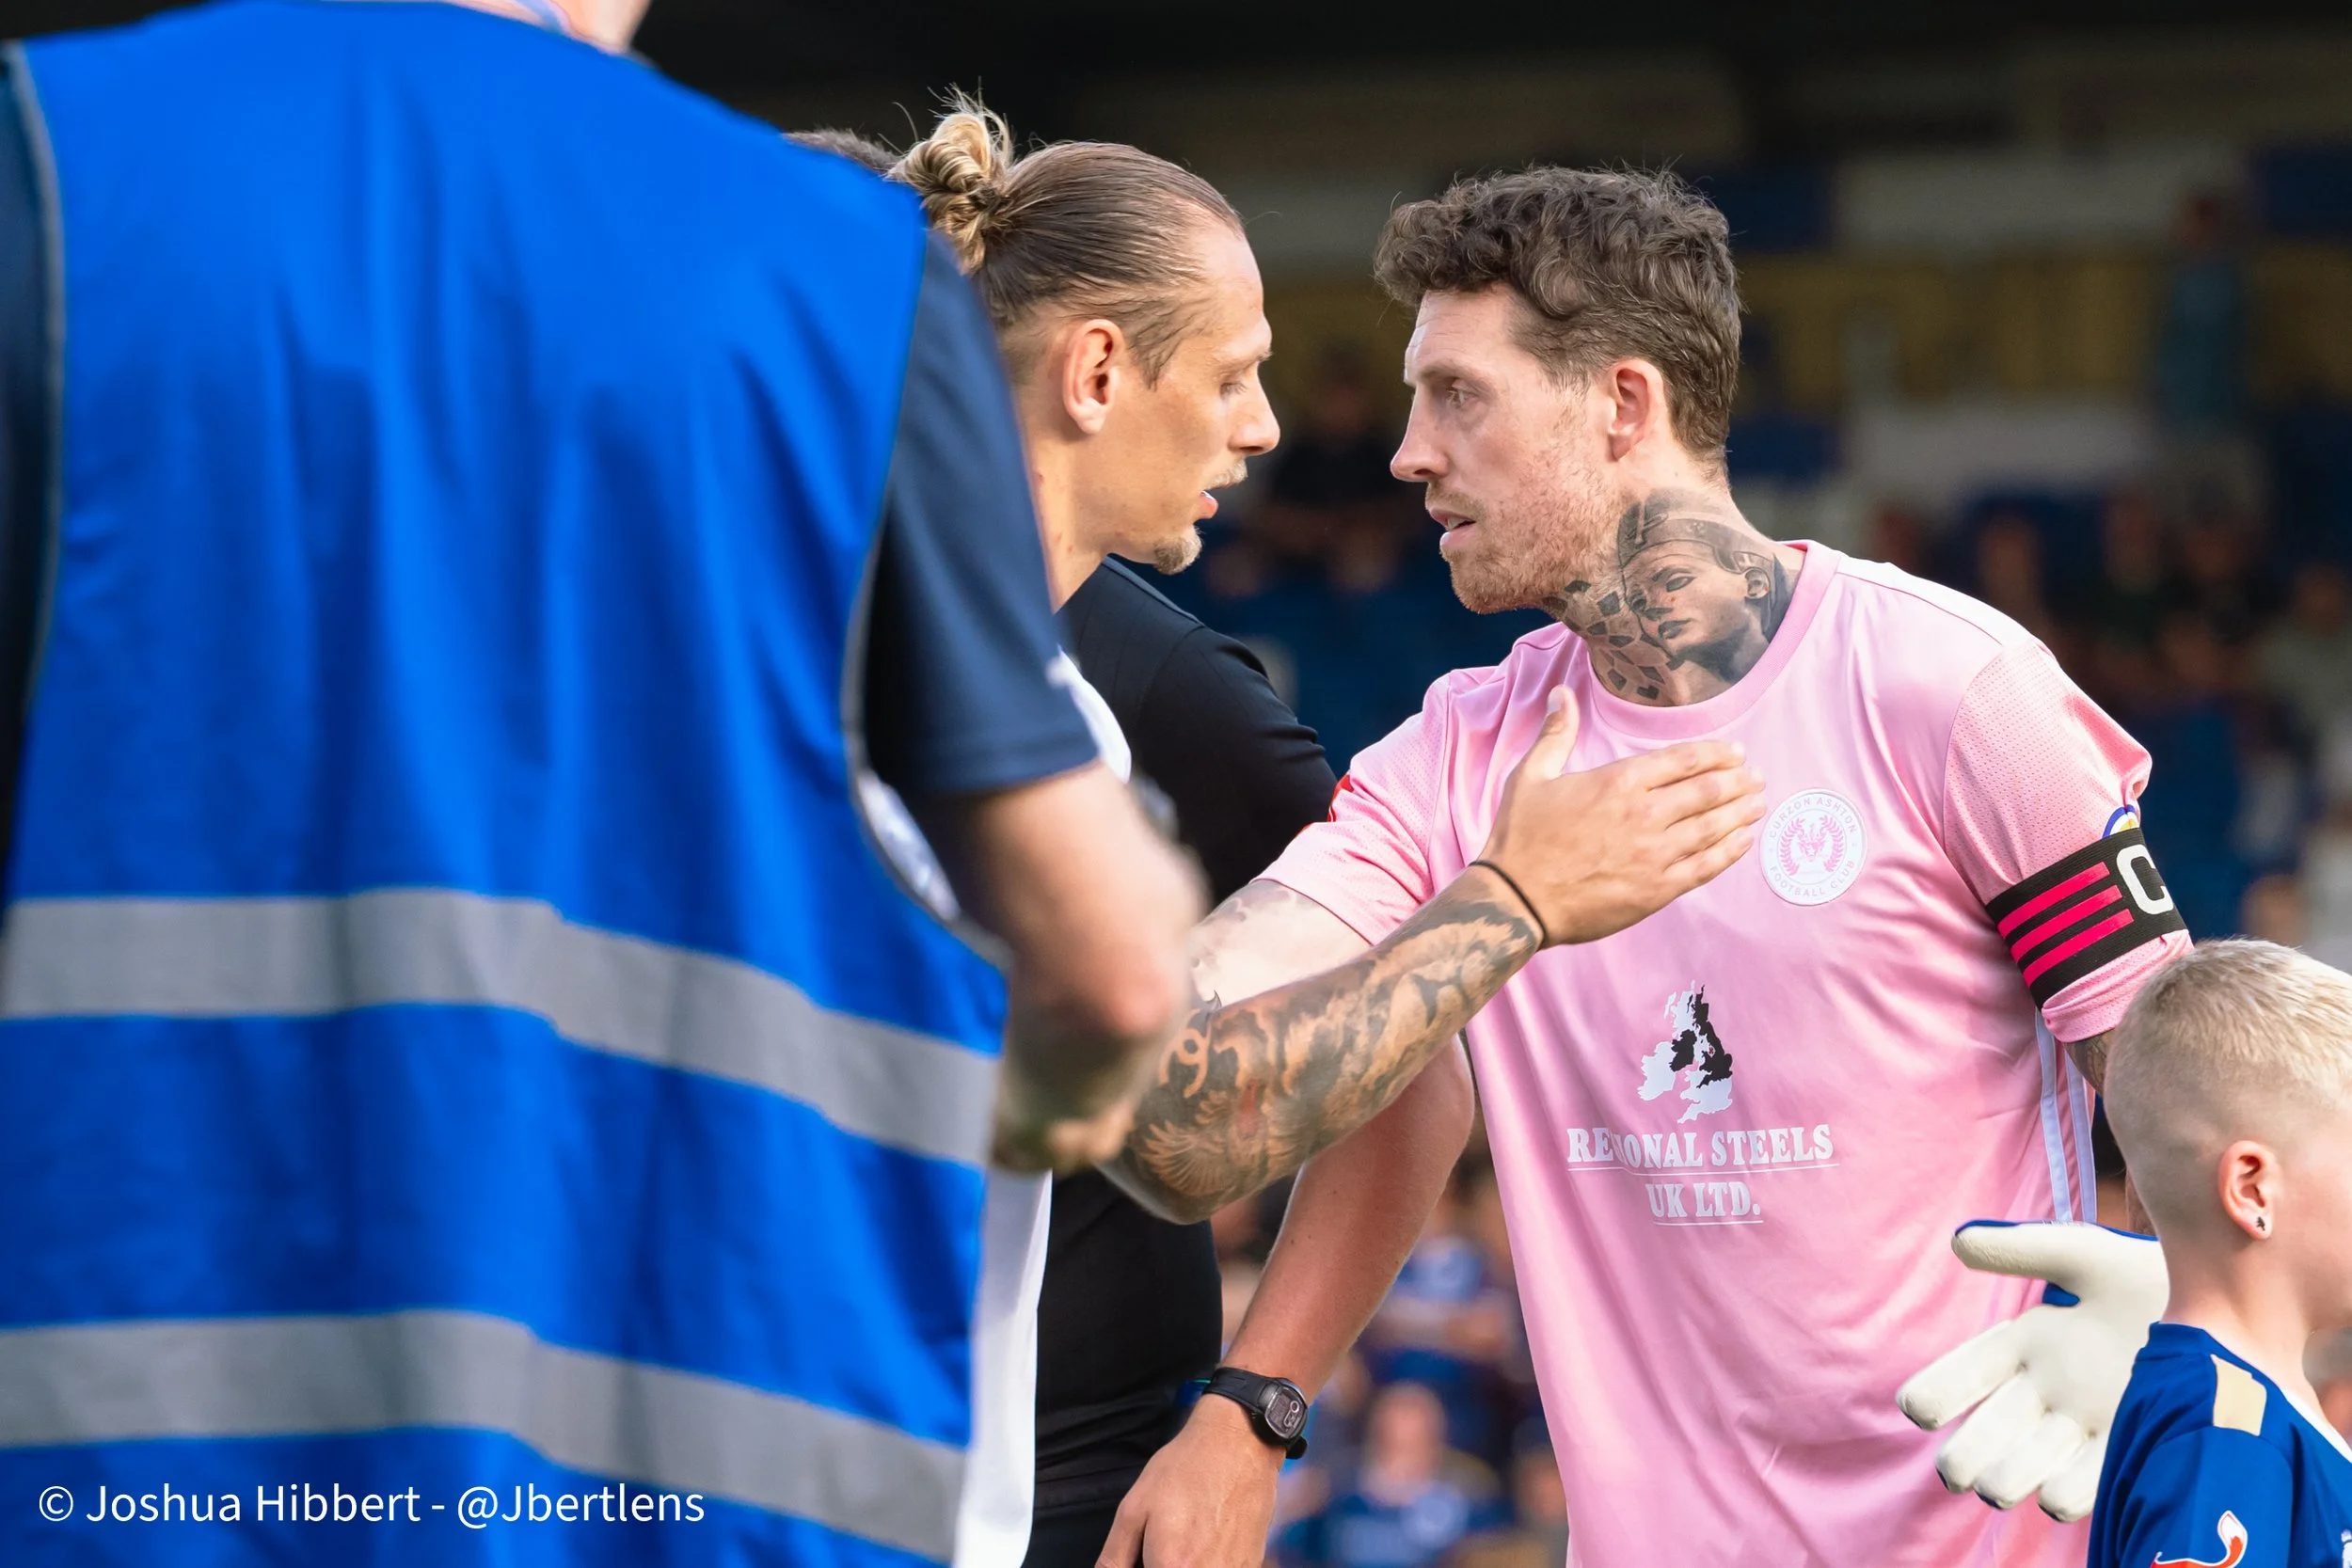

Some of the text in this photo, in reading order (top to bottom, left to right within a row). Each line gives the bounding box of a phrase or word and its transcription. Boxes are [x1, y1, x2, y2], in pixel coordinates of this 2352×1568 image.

[1770, 797, 1858, 838] CURZON ASHTON
[1770, 860, 1855, 897] FOOTBALL CLUB
[2116, 844, 2174, 915] C
[1566, 1124, 1834, 1169] REIONAL STEELS
[1645, 1181, 1761, 1218] UK LTD.
